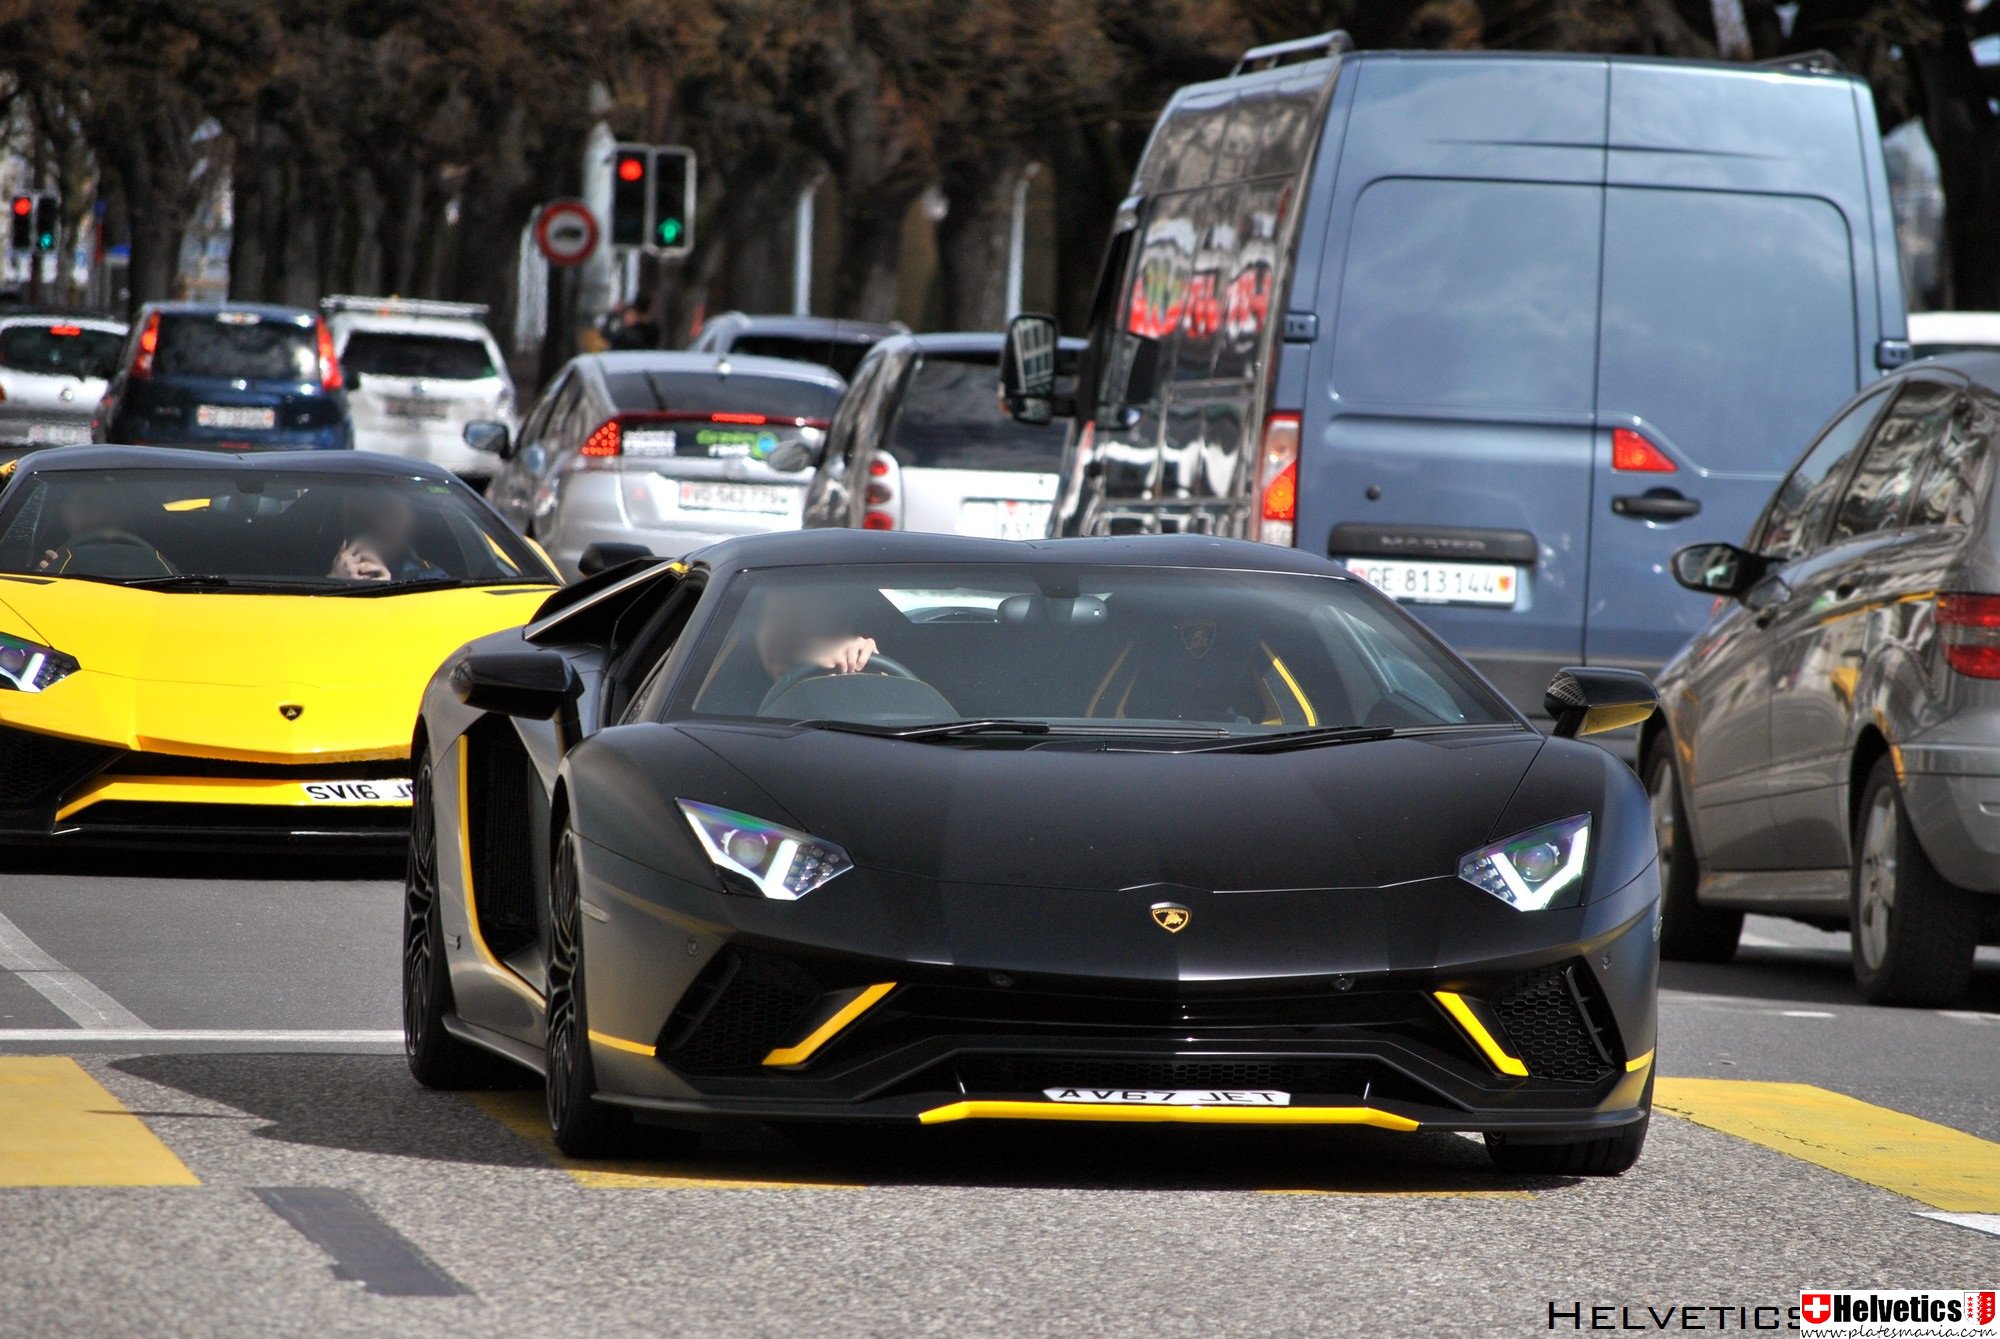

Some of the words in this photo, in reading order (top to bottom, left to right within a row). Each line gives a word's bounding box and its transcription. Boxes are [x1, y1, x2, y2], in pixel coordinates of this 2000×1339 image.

[1367, 567, 1395, 591] GE
[1405, 568, 1494, 594] 813144
[306, 784, 380, 799] SV16
[1058, 1089, 1176, 1101] AV67
[1198, 1092, 1276, 1102] JET
